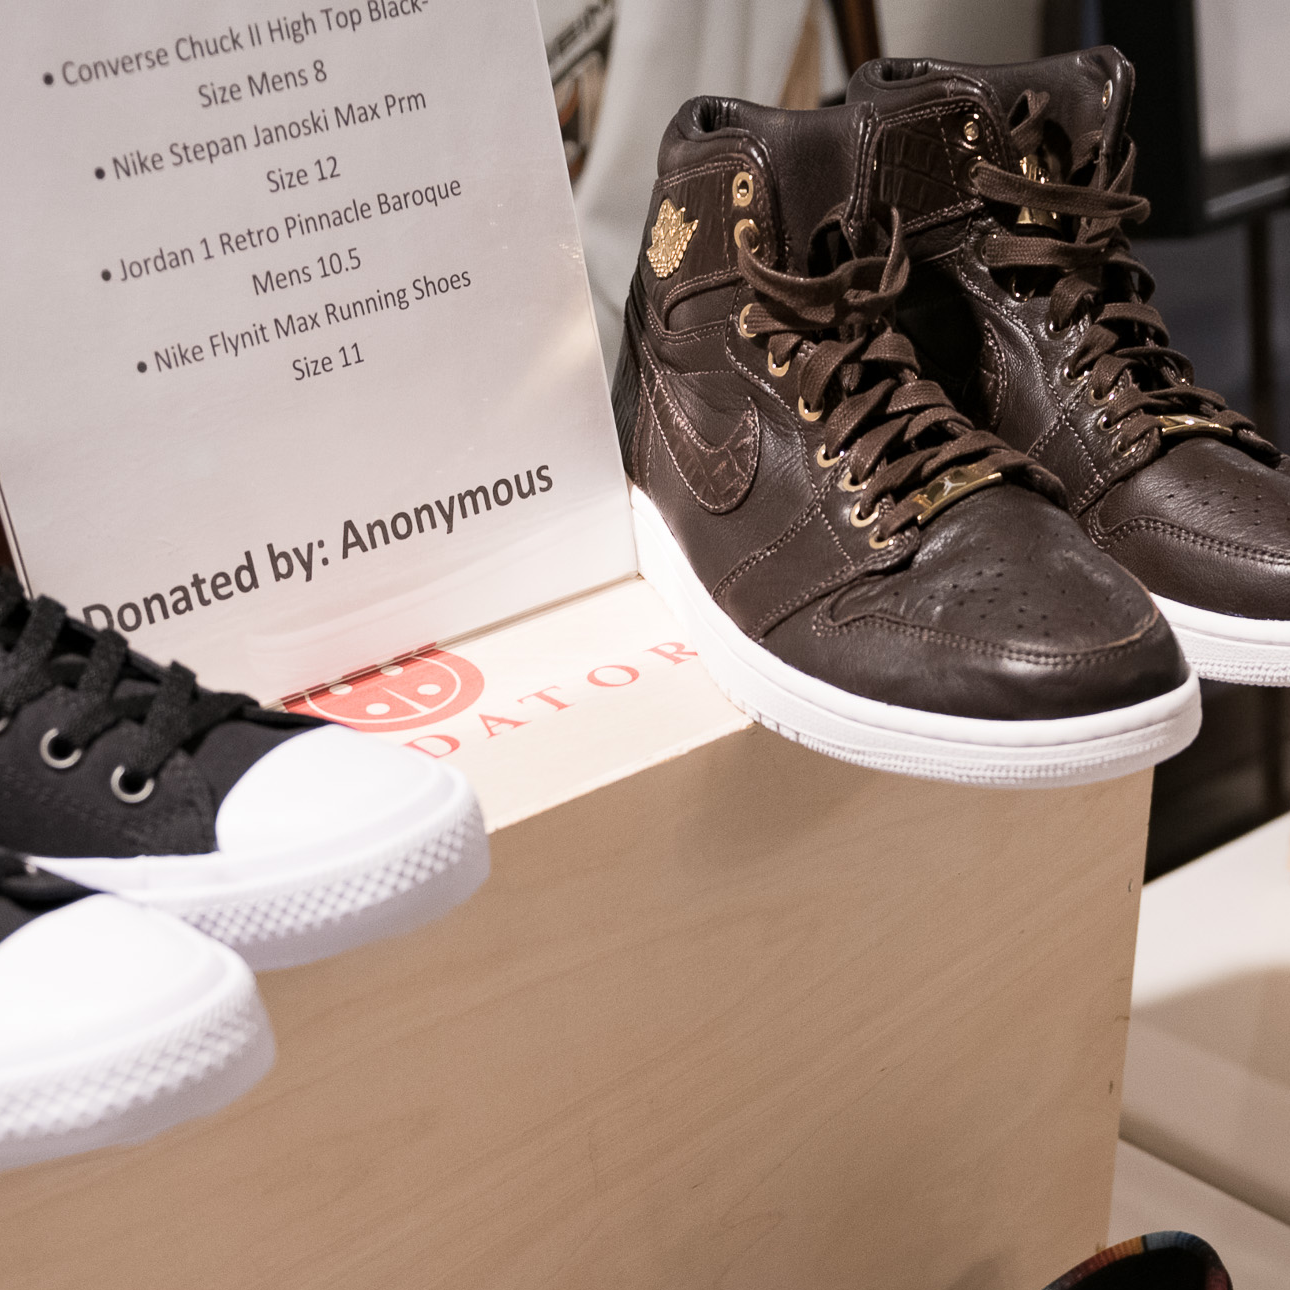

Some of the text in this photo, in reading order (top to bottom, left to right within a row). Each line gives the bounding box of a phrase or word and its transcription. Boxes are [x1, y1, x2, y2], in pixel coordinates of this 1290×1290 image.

[61, 47, 169, 86] Converse
[175, 26, 244, 62] Chuck
[268, 13, 317, 43] High
[321, 5, 362, 34] Top
[198, 60, 328, 108] Size Mens 8
[112, 90, 427, 180] Nike Stepan Janoski Max Prm
[267, 156, 341, 193] Size 12
[119, 180, 462, 282] Jordan 1 Retro Pinnacle Baroque
[252, 247, 362, 296] Mens 10.5
[154, 270, 472, 373] Nike Flynit Max Running Shoes
[292, 342, 365, 381] Size 11
[82, 464, 554, 634] Donated by: Anonymous
